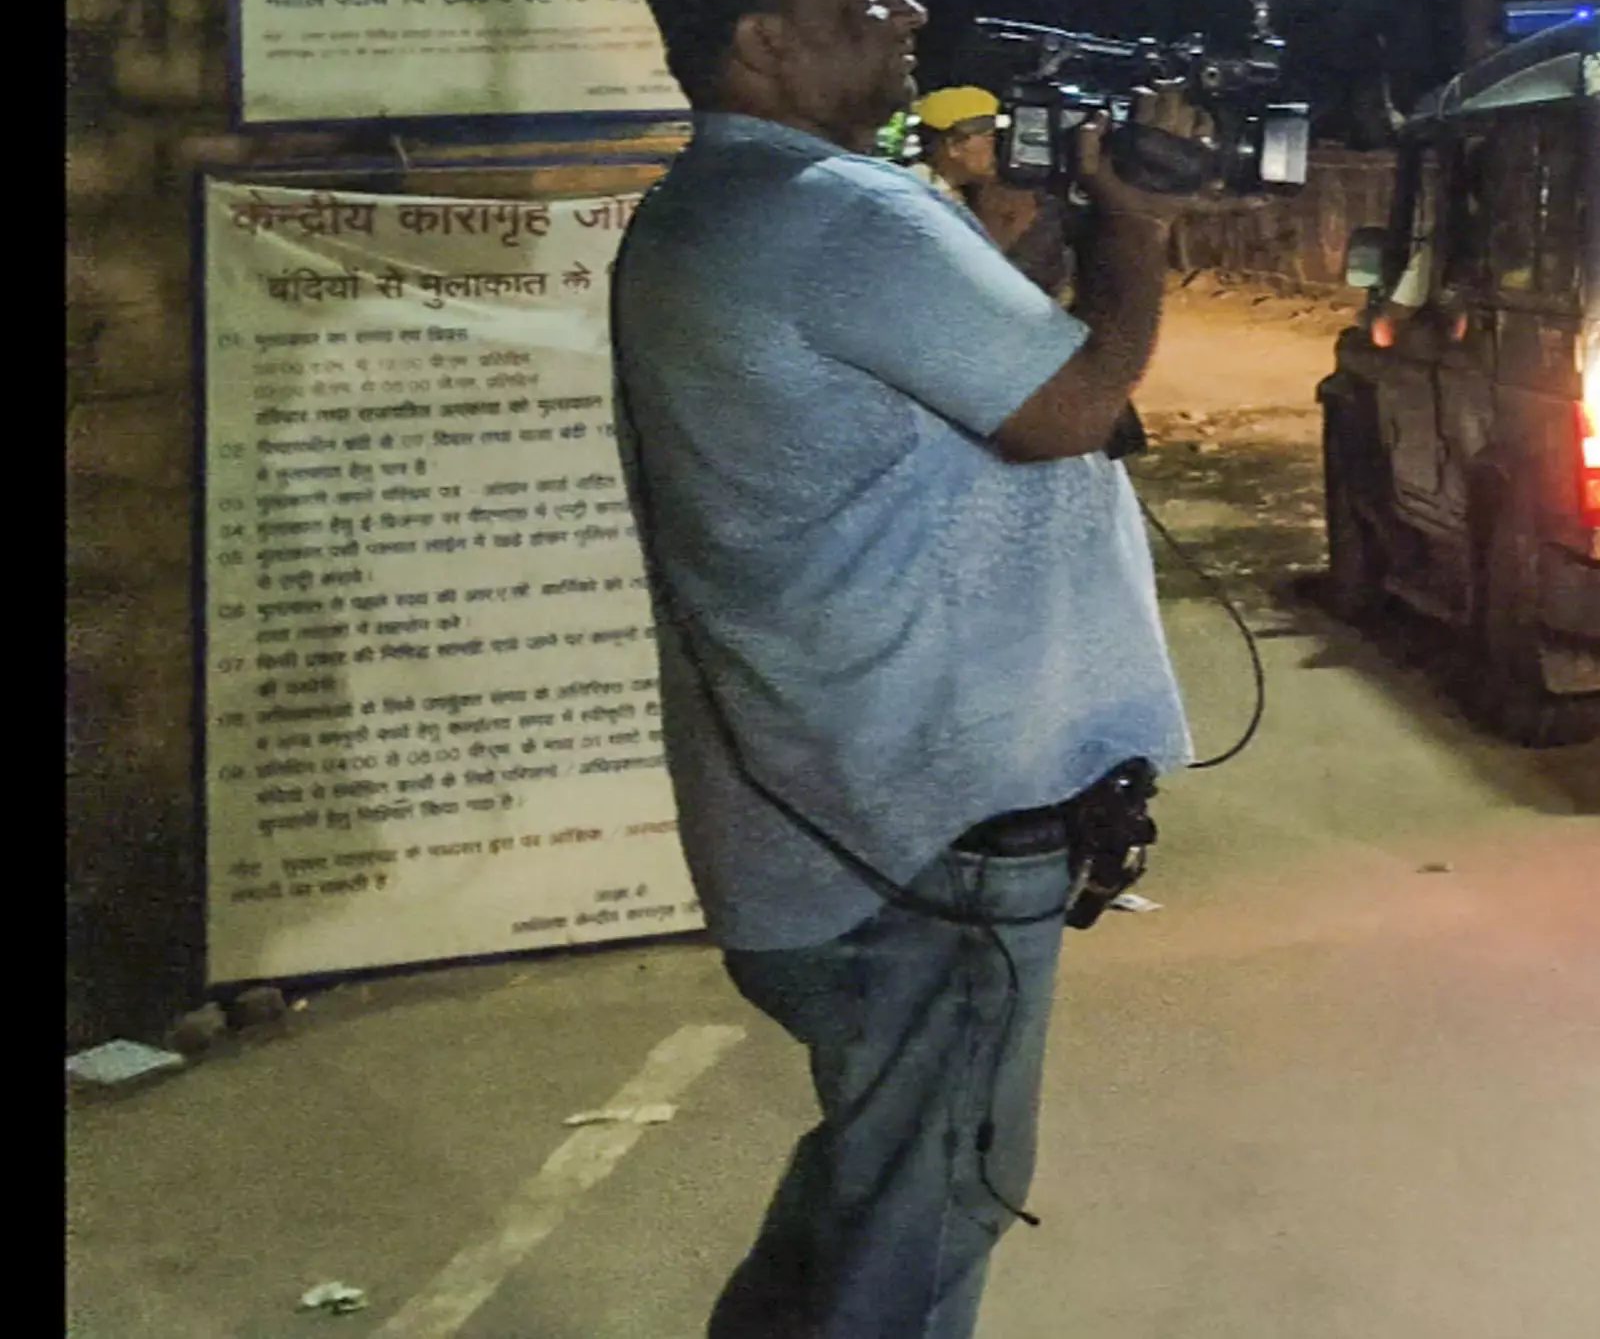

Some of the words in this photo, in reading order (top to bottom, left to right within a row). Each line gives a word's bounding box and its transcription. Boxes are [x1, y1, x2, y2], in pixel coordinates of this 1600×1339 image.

[231, 188, 377, 237] केन्द्रीय
[398, 204, 551, 247] कारागृह
[419, 272, 550, 310] मुलाकात
